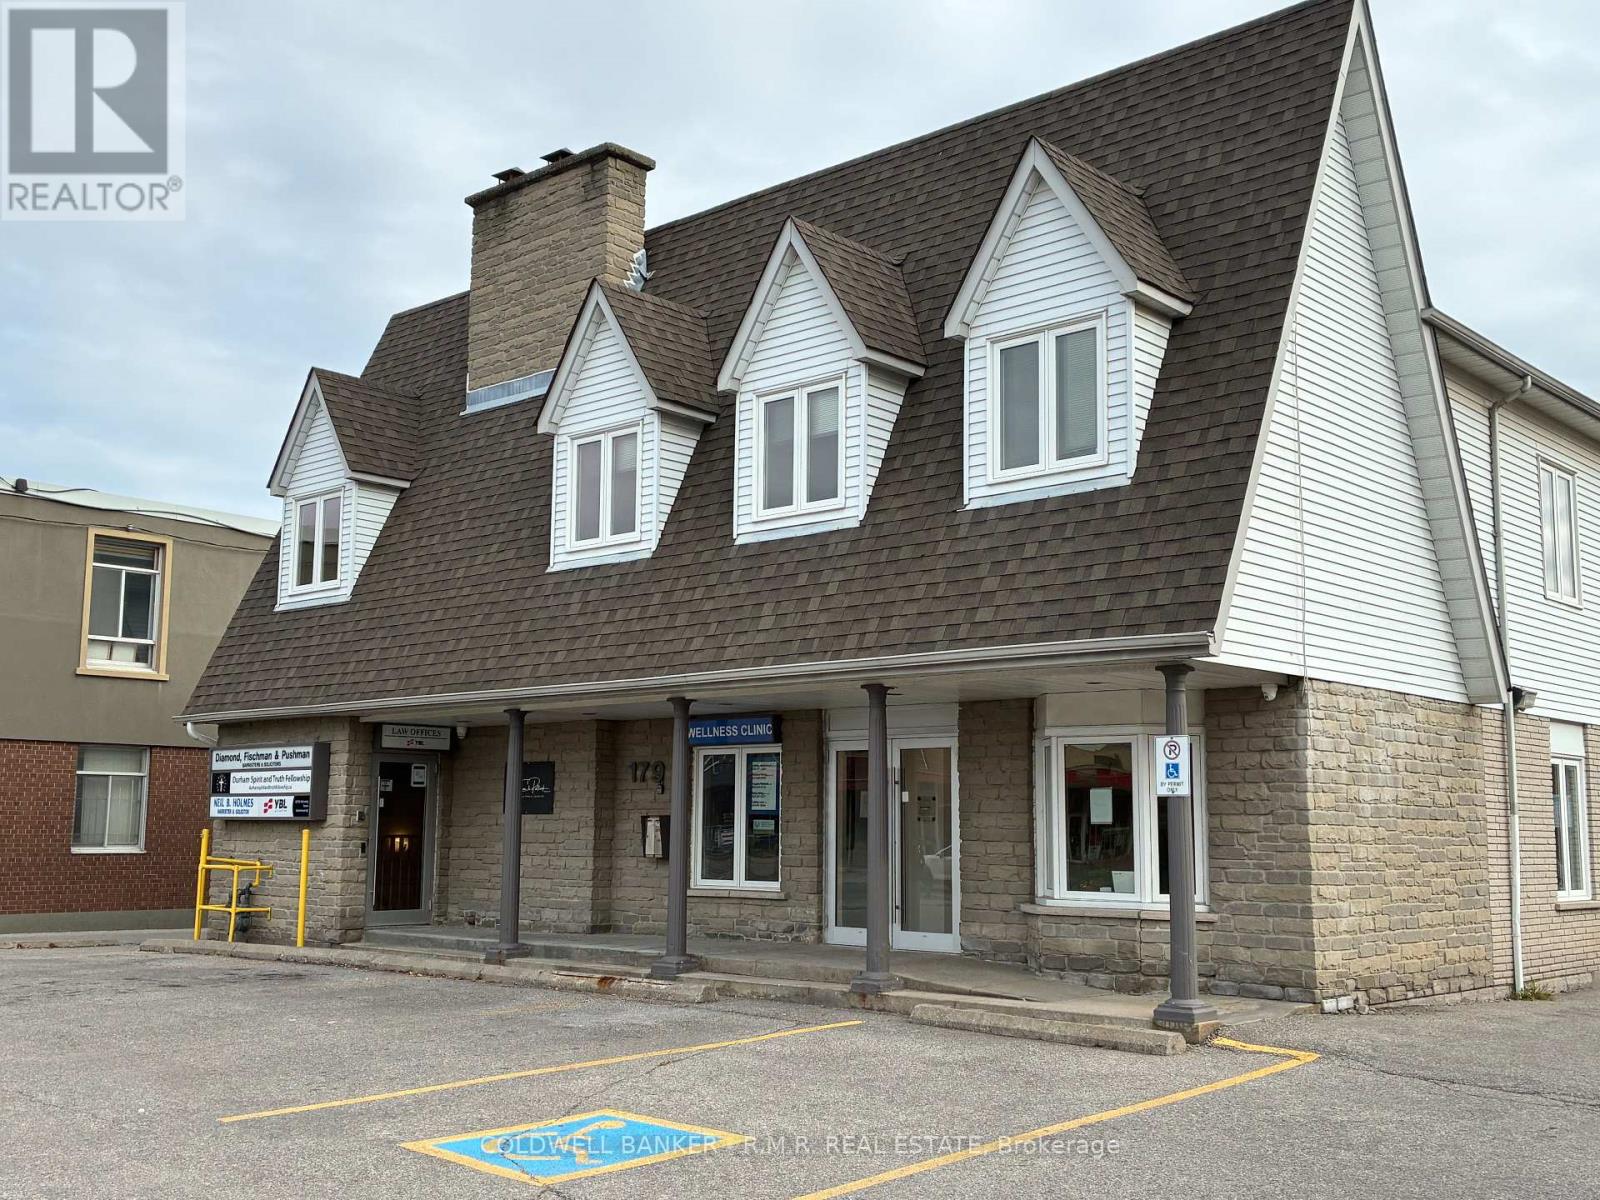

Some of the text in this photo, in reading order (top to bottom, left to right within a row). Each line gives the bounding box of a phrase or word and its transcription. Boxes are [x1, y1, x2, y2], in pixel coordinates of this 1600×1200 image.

[391, 727, 441, 737] LAW OFFICES
[688, 723, 773, 738] WELLNESS CLINIC
[215, 750, 310, 763] Diamond, Fischman & Pushman
[232, 773, 311, 785] Durham Spirit and Truth Fellowship
[214, 798, 224, 808] NEIL
[232, 798, 254, 808] HOLMES
[274, 798, 288, 809] YBL
